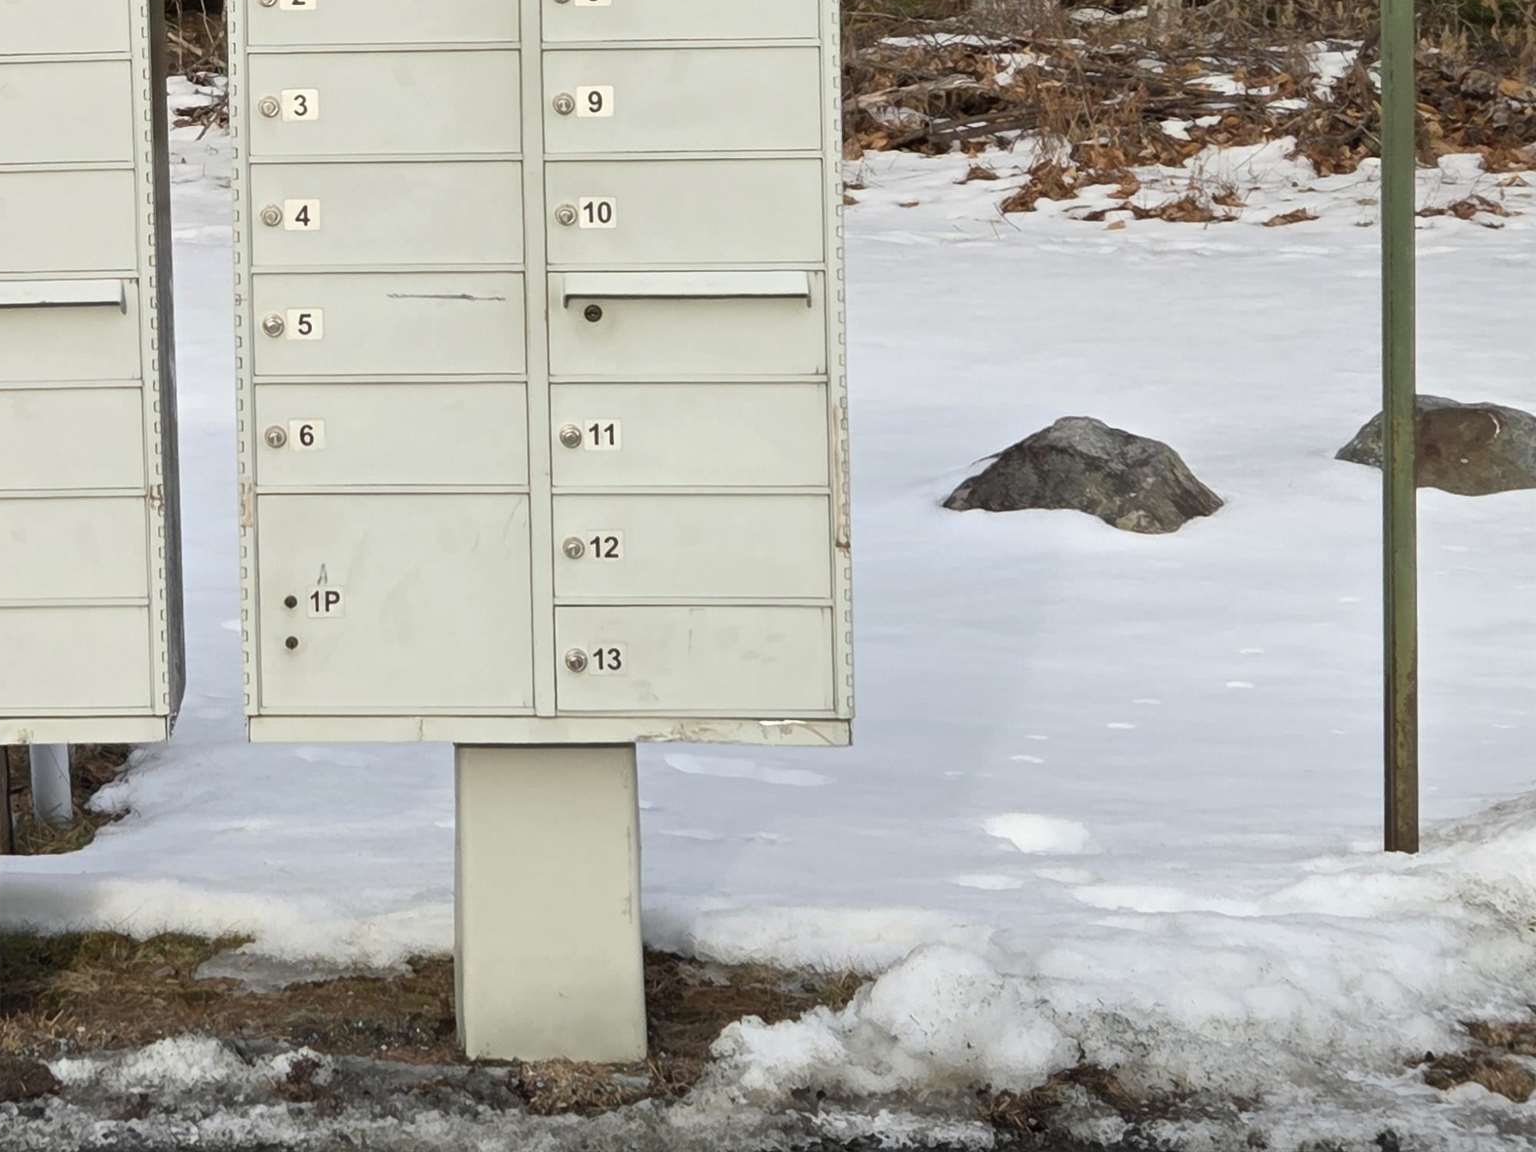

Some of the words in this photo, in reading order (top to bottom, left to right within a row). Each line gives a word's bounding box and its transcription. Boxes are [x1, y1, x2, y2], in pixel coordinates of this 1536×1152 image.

[293, 94, 308, 117] 3
[587, 90, 603, 113] 9
[294, 204, 311, 227] 4
[583, 201, 612, 224] 10
[298, 313, 313, 336] 5
[299, 424, 314, 447] 6
[588, 423, 615, 446] 11
[589, 535, 619, 558] 12
[310, 590, 340, 613] 1P
[592, 647, 622, 668] 13
